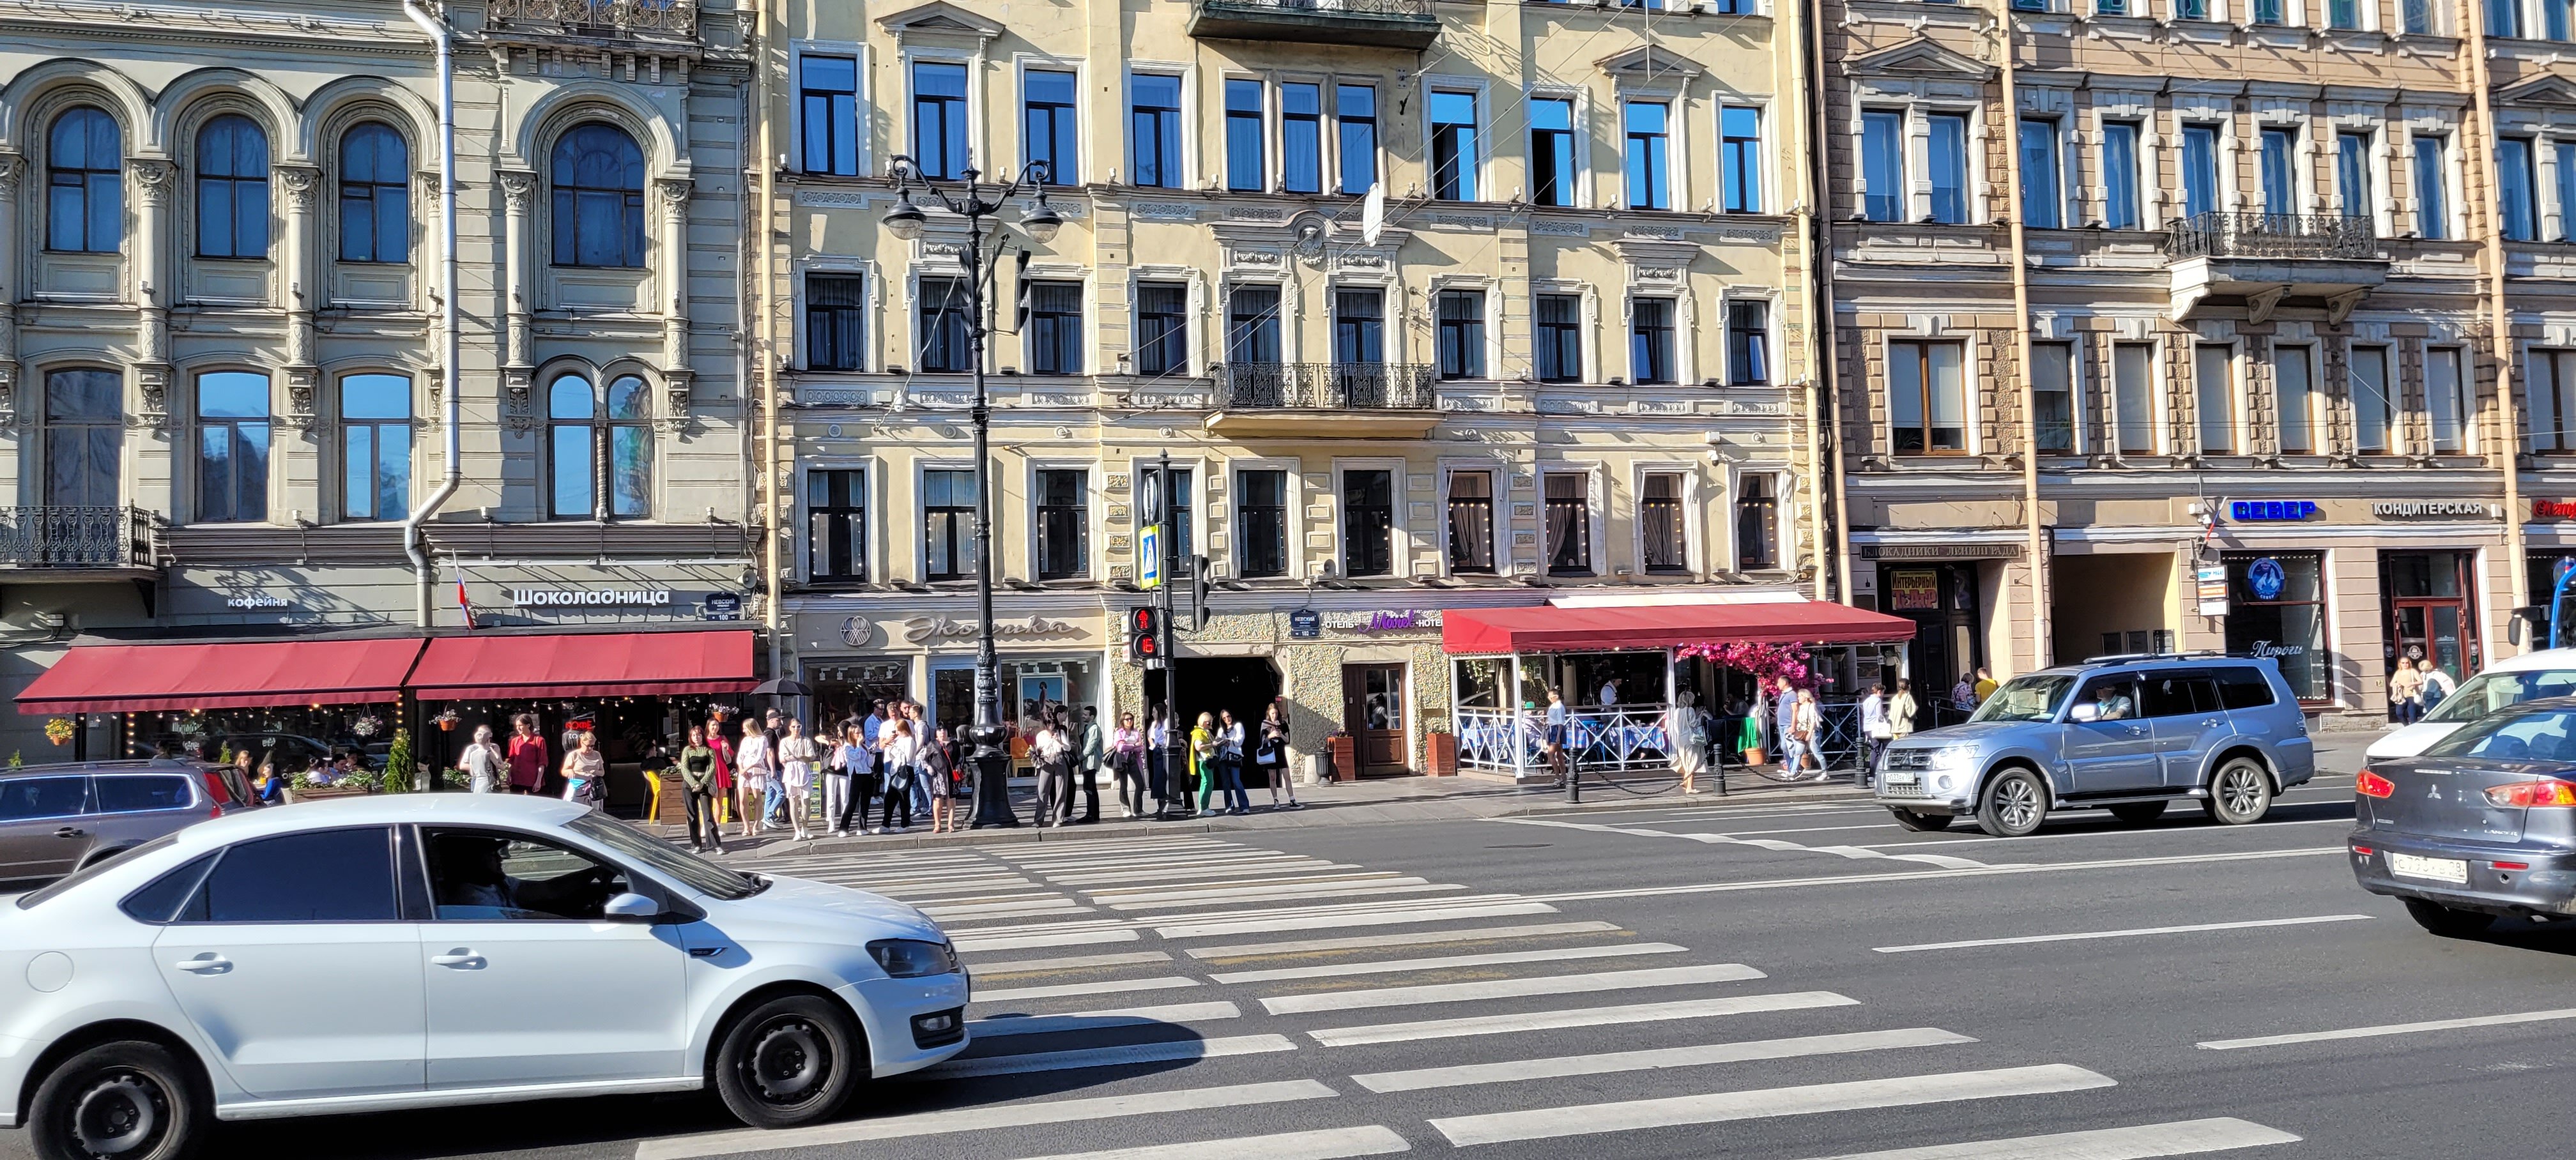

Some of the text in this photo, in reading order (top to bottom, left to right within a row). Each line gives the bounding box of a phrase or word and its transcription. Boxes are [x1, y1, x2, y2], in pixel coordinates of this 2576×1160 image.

[2230, 501, 2316, 519] СЕВЕР
[2374, 502, 2483, 517] КОНДИТЕРСКАЯ
[1863, 546, 2017, 558] БЛОКАДНИКИ ЛЕНИНГРАДА
[227, 595, 288, 609] кофейня
[513, 588, 670, 606] Шоколадница
[903, 614, 1082, 641] Экоика
[1325, 620, 1354, 629] ОТЕЛЬ
[1142, 637, 1153, 653] 16
[2250, 640, 2303, 658] Пироги
